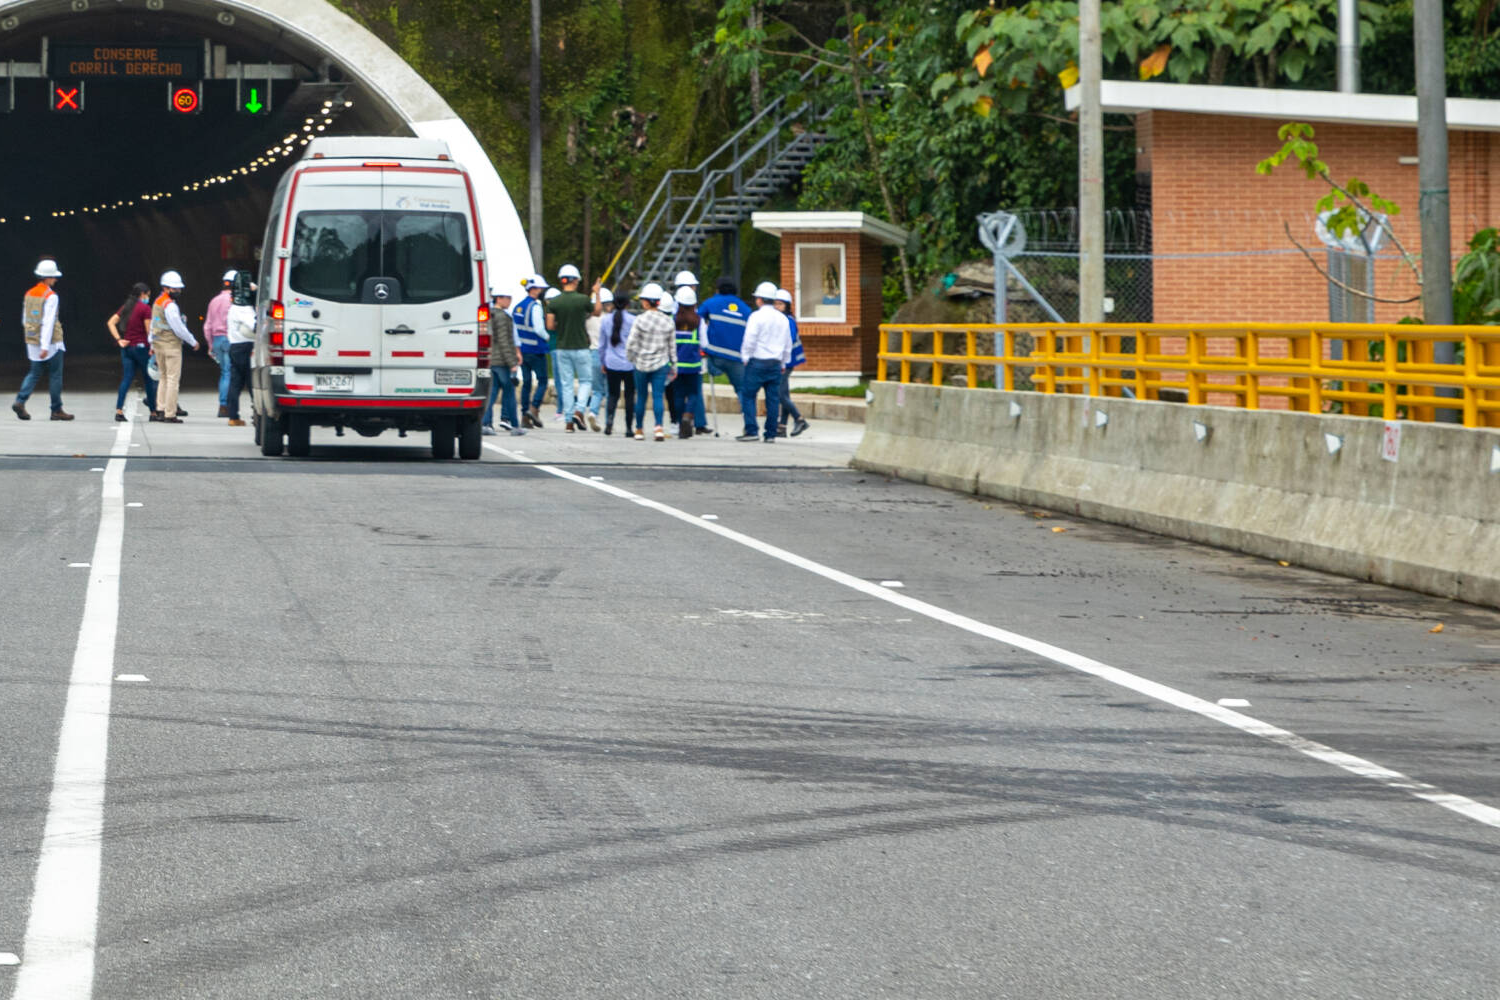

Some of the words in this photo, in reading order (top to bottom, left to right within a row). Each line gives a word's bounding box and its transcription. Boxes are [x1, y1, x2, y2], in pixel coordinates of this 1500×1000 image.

[93, 47, 158, 61] CONSERVE
[69, 61, 117, 75] CARRIL
[125, 62, 183, 76] DERECHO
[178, 95, 192, 106] 60
[288, 331, 322, 349] 036
